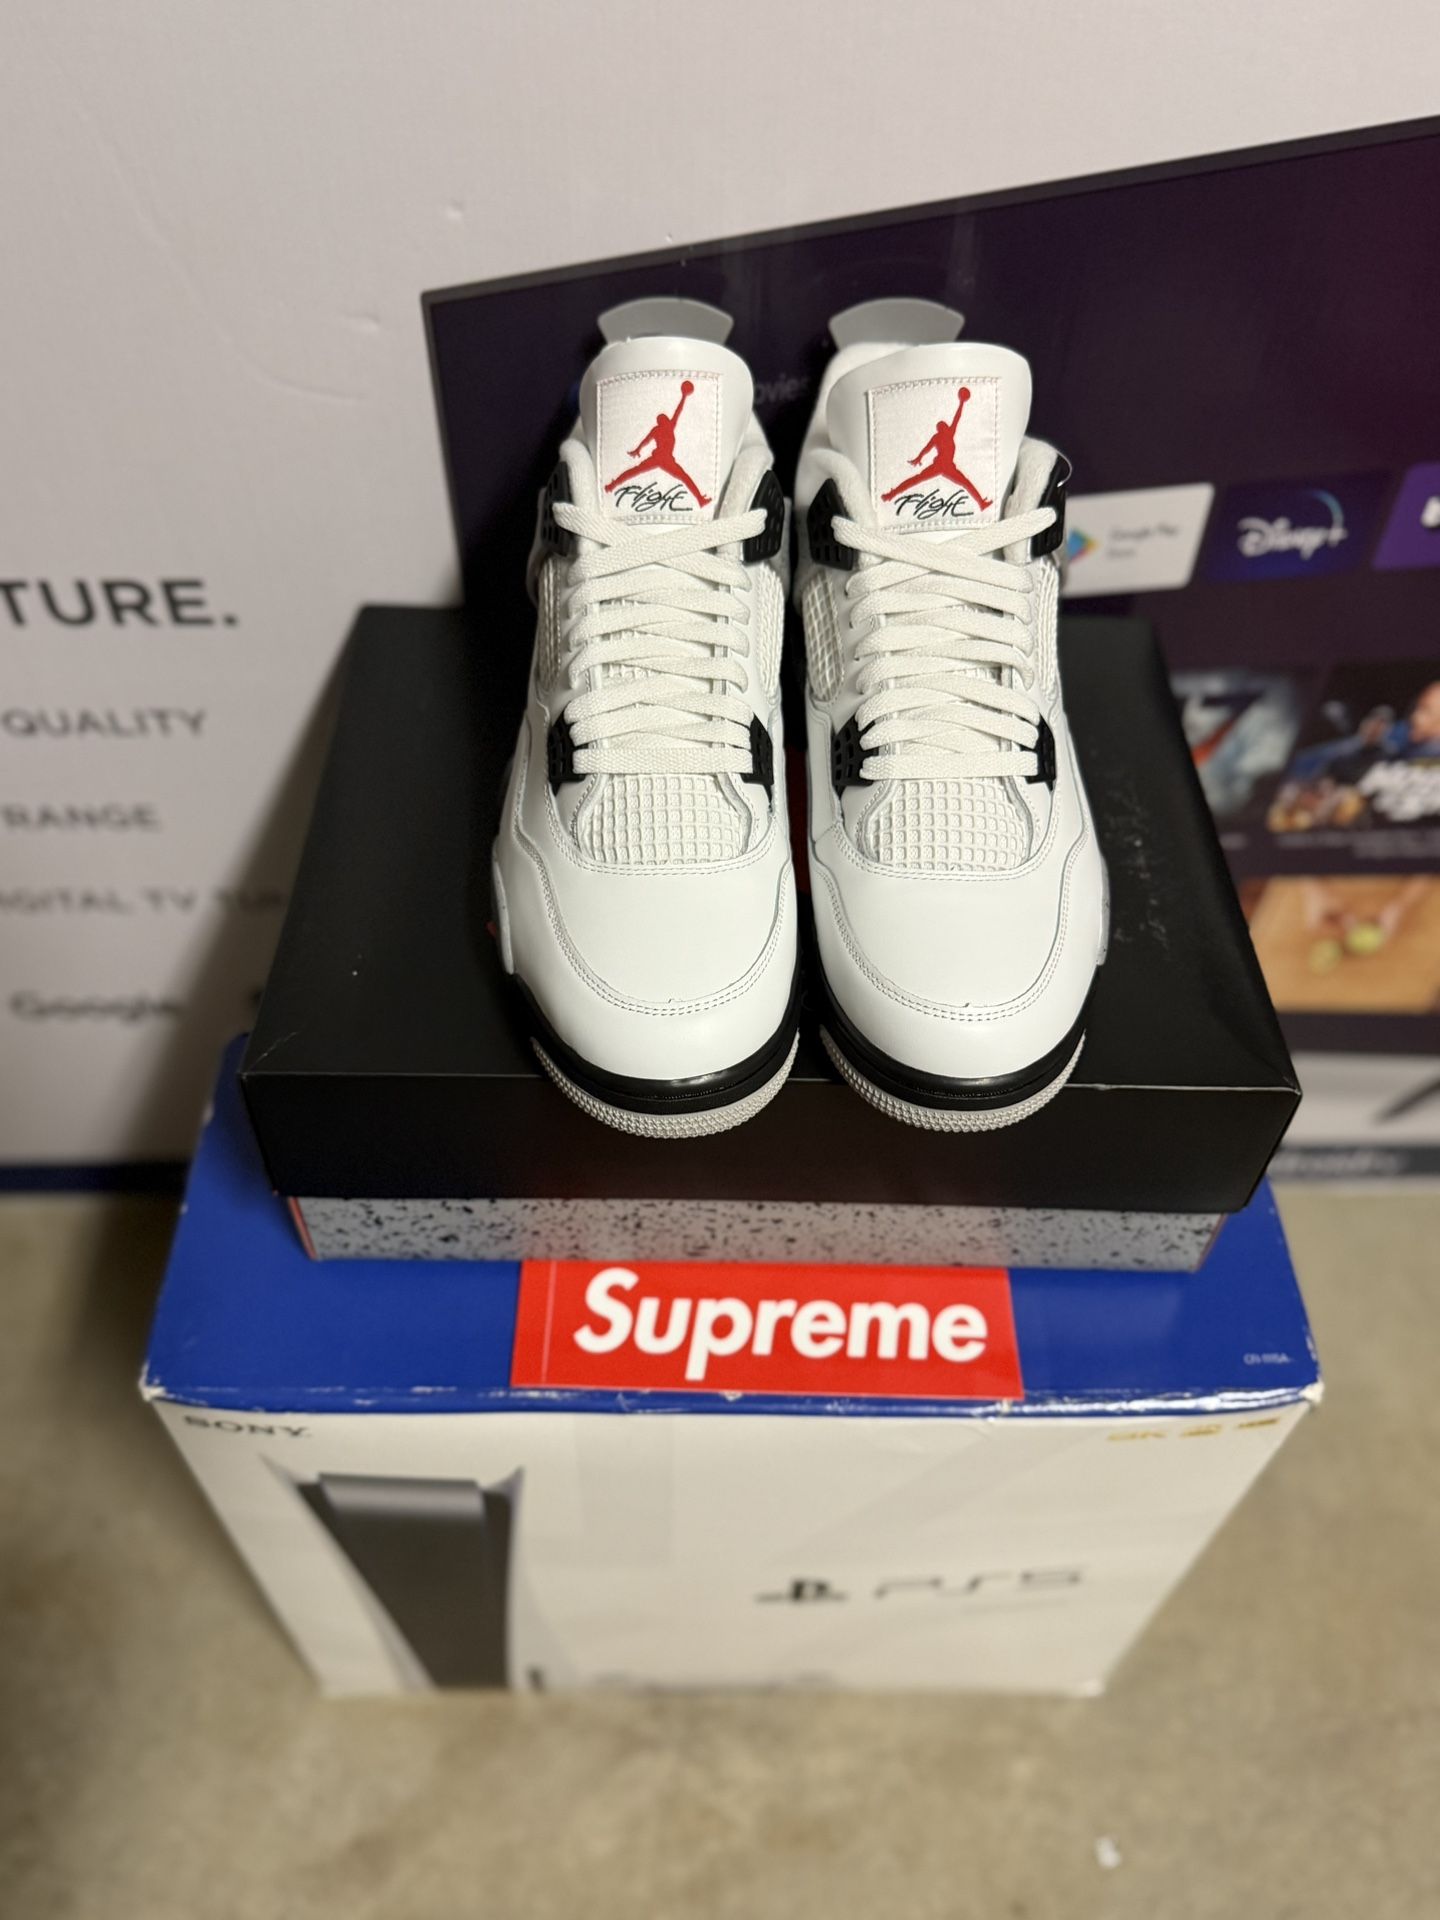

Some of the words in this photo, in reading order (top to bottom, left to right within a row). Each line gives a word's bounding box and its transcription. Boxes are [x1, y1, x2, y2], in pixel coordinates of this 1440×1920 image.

[614, 481, 692, 512] Flight
[894, 488, 974, 520] Flight
[0, 579, 238, 627] TURE.
[2, 707, 205, 738] QUALITY
[3, 805, 161, 831] RANGE
[573, 1267, 988, 1381] Supreme
[183, 1415, 307, 1437] SONY
